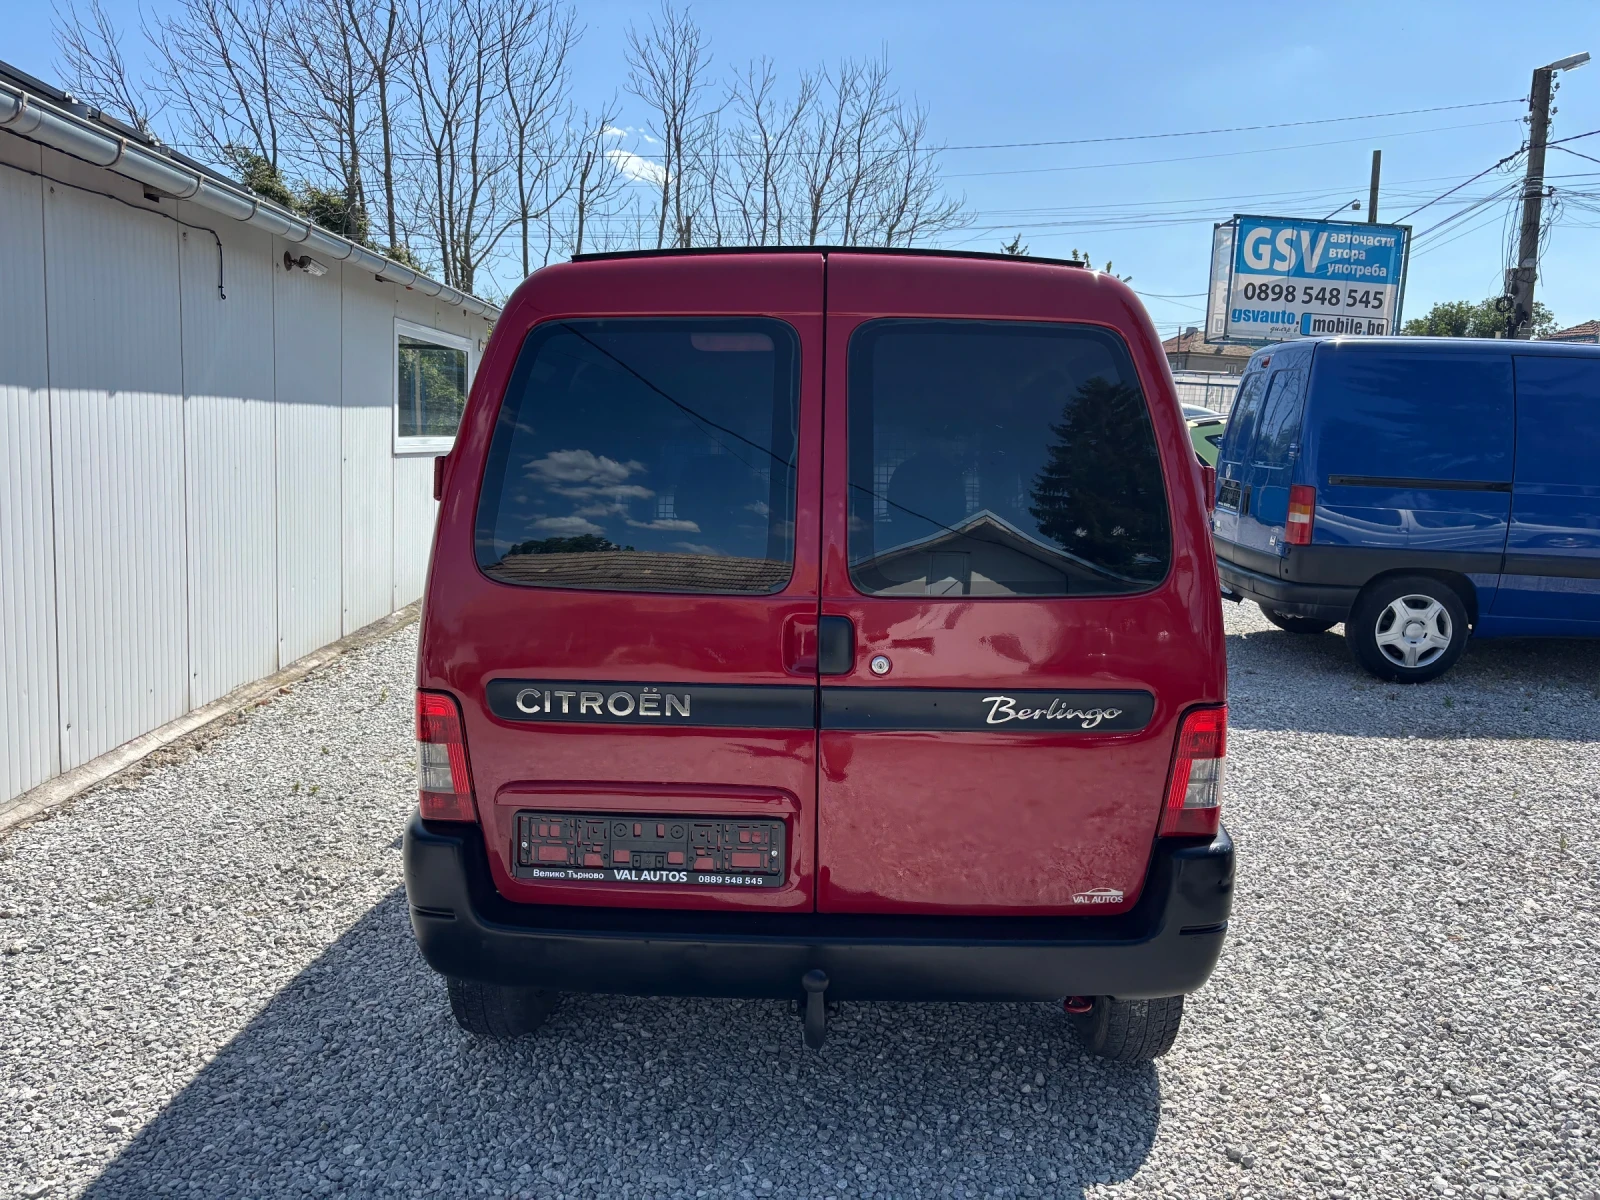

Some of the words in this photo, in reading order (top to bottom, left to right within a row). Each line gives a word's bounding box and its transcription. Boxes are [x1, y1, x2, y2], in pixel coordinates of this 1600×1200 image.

[1330, 233, 1395, 247] авточасти
[1244, 227, 1328, 273] GSV
[1329, 248, 1366, 263] втора
[1327, 262, 1387, 278] употреба
[1243, 282, 1297, 303] 0898
[1301, 287, 1341, 306] 548
[1346, 289, 1384, 309] 545
[515, 686, 691, 717] CITROËN
[982, 695, 1123, 729] Berlingo
[533, 869, 566, 879] Велико
[567, 870, 604, 880] Търново
[614, 869, 639, 881] VAL
[640, 871, 688, 883] AUTOS
[698, 875, 722, 885] 0889
[725, 876, 743, 885] 548
[745, 876, 763, 885] 545
[1072, 895, 1090, 903] VAL
[1091, 895, 1123, 903] AUTOS
